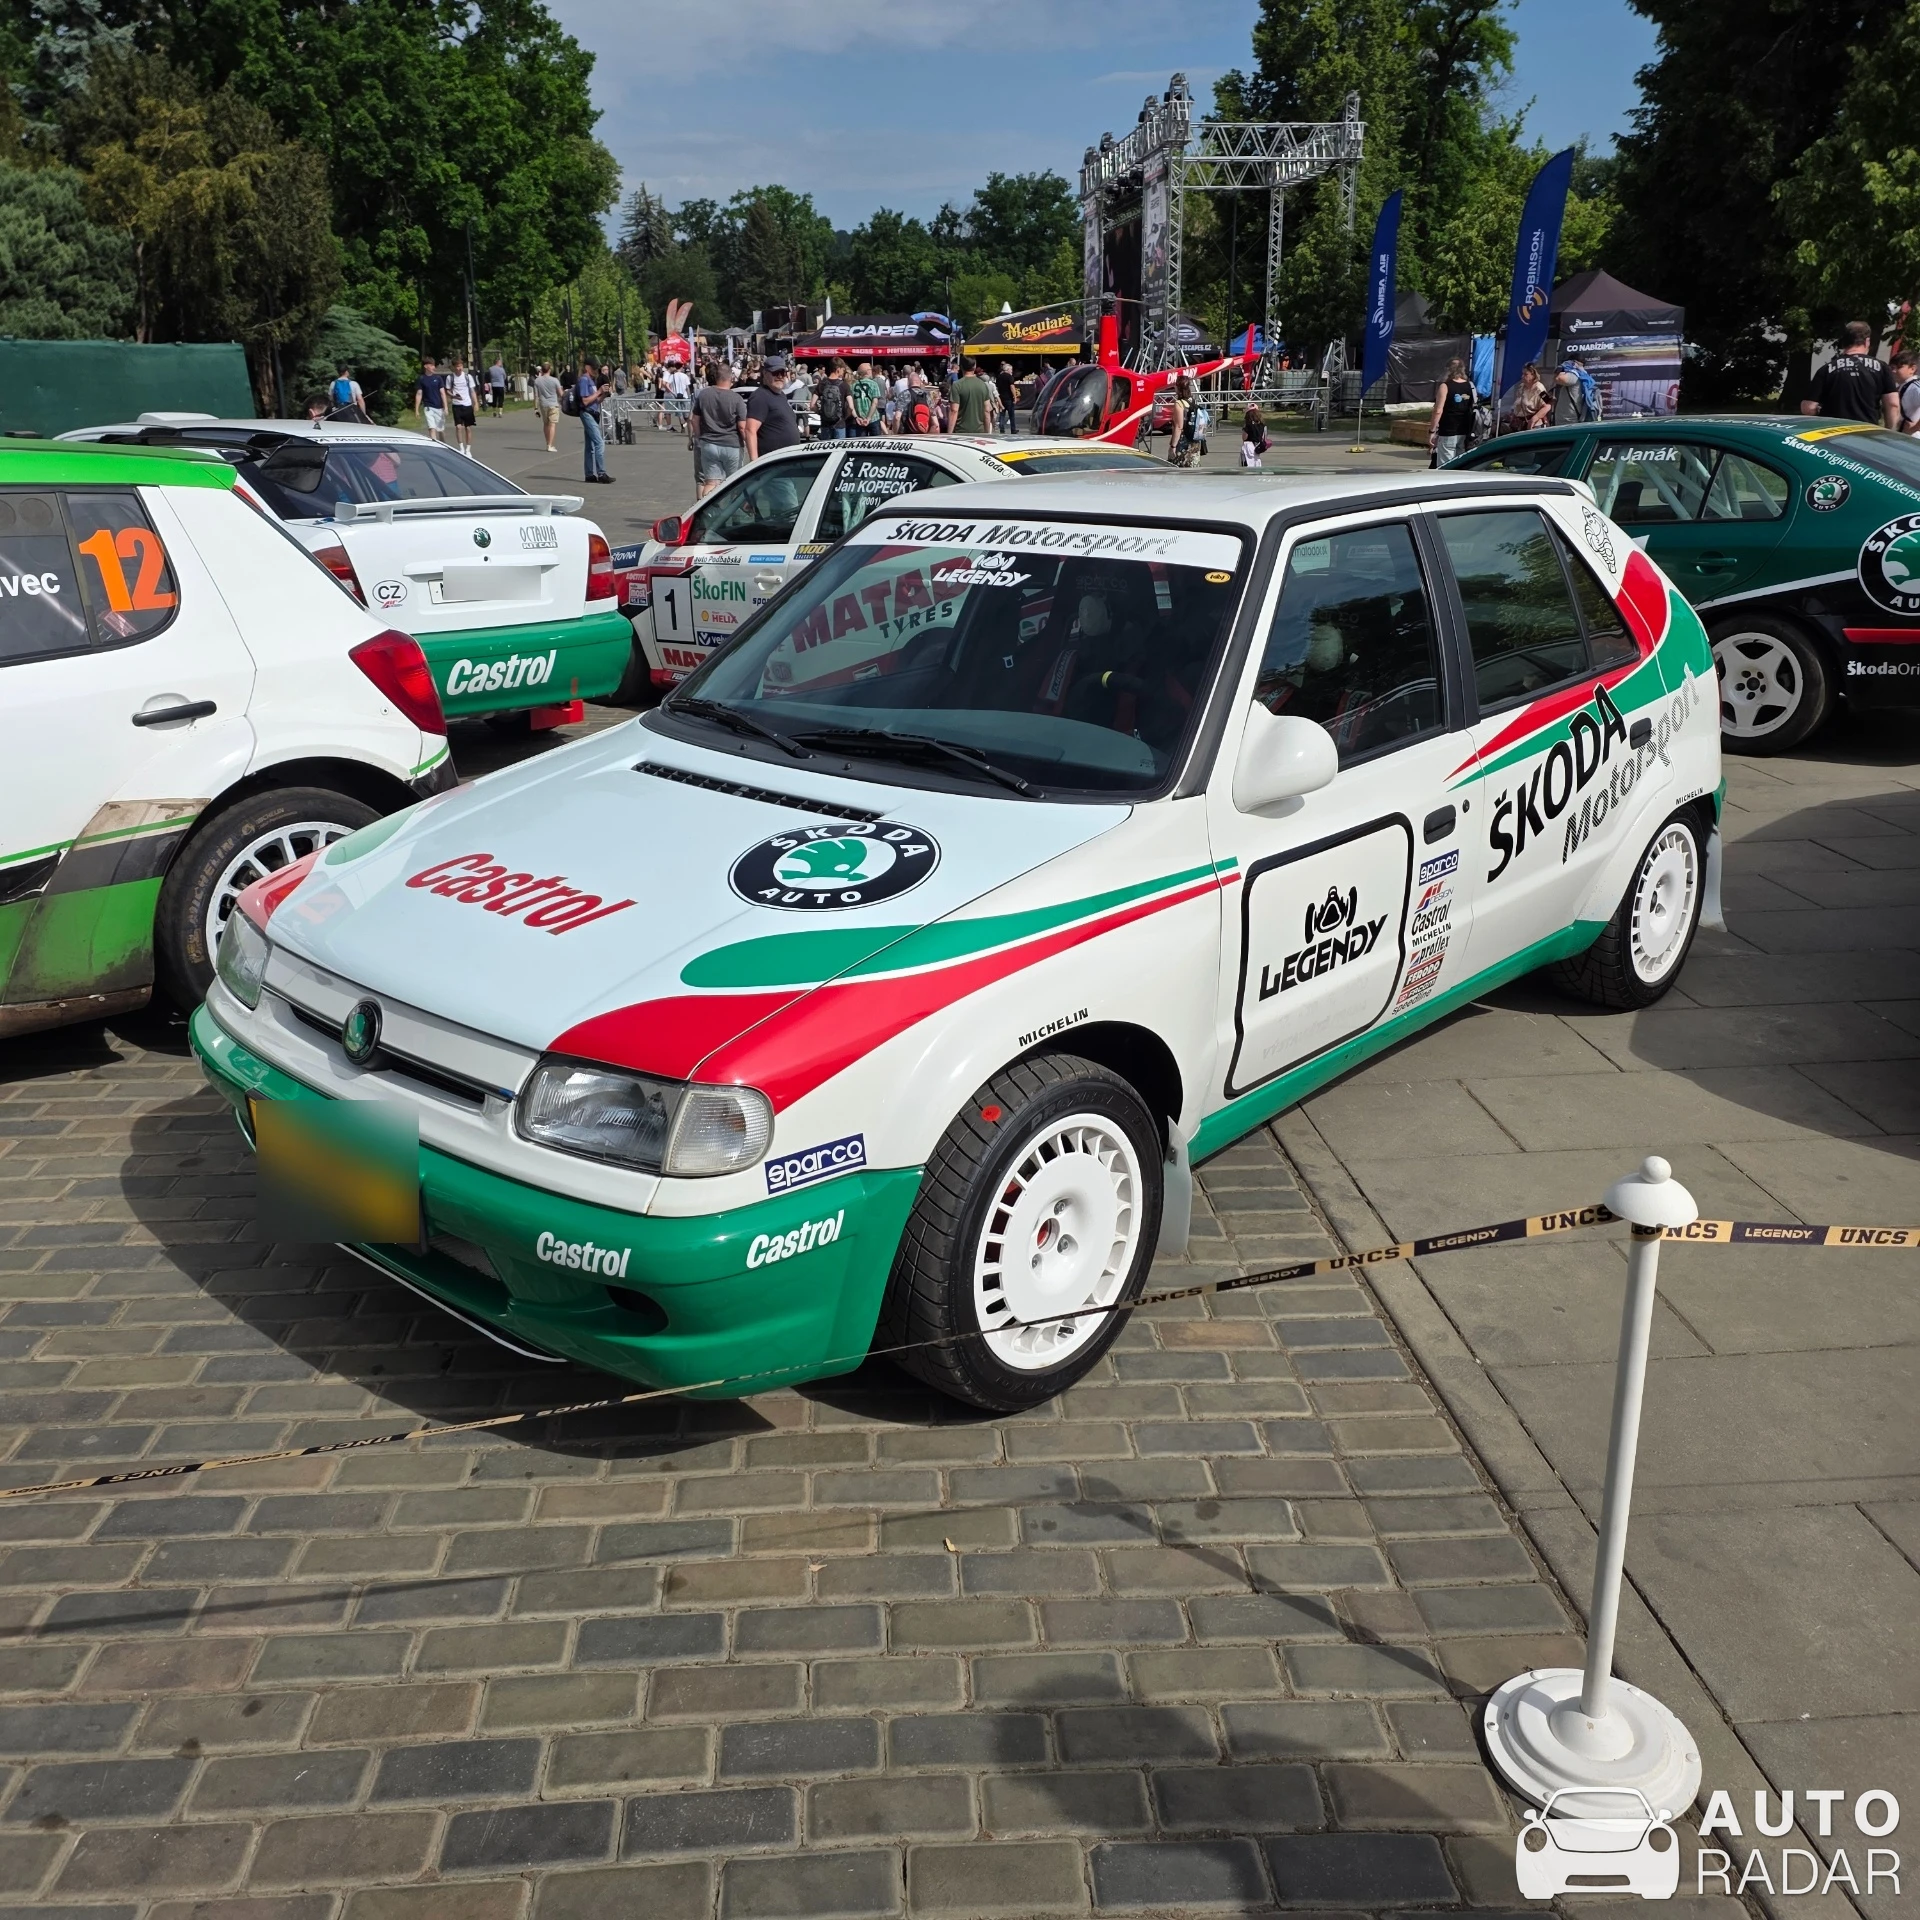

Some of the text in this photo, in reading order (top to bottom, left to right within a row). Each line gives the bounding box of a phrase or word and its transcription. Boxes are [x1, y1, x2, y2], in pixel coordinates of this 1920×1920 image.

[820, 324, 919, 338] ESCAPE6
[841, 457, 909, 479] Š. Rosina
[1599, 447, 1679, 462] J. Janák
[835, 478, 918, 494] Jan KOPECKÝ
[519, 525, 557, 542] OCTAVIA
[886, 520, 1181, 556] ŠKODA Motorsport
[79, 527, 179, 612] 12
[932, 568, 1031, 588] LEGENDY
[0, 572, 61, 598] vec
[378, 585, 401, 600] CZ
[693, 575, 746, 601] ŠkoFIN
[665, 589, 677, 631] 1
[712, 613, 738, 624] HELIX
[879, 601, 953, 639] TYRES
[446, 650, 556, 696] Castrol
[1563, 663, 1700, 865] Motorsport
[1487, 682, 1627, 883] ŠKODA
[1675, 787, 1703, 805] MICHELIN
[1420, 853, 1458, 881] sparco
[405, 853, 638, 935] Castrol
[758, 887, 862, 904] AUTO
[1412, 899, 1452, 936] Castrol
[1412, 922, 1452, 947] MICHELIN
[1259, 914, 1388, 1002] LEGENDY
[1018, 1008, 1089, 1047] MICHELIN
[768, 1140, 863, 1187] sparco
[1541, 1204, 1613, 1231] UNCS
[745, 1209, 845, 1269] Castrol
[1329, 1228, 1499, 1269] UNCS LEGENDY
[1744, 1227, 1814, 1239] LEGENDY
[1839, 1228, 1908, 1244] UNCS
[536, 1231, 632, 1278] Castrol
[1133, 1268, 1301, 1306] UNCS LEGENDY
[316, 1436, 393, 1452] UNCS
[108, 1466, 186, 1483] UNCS
